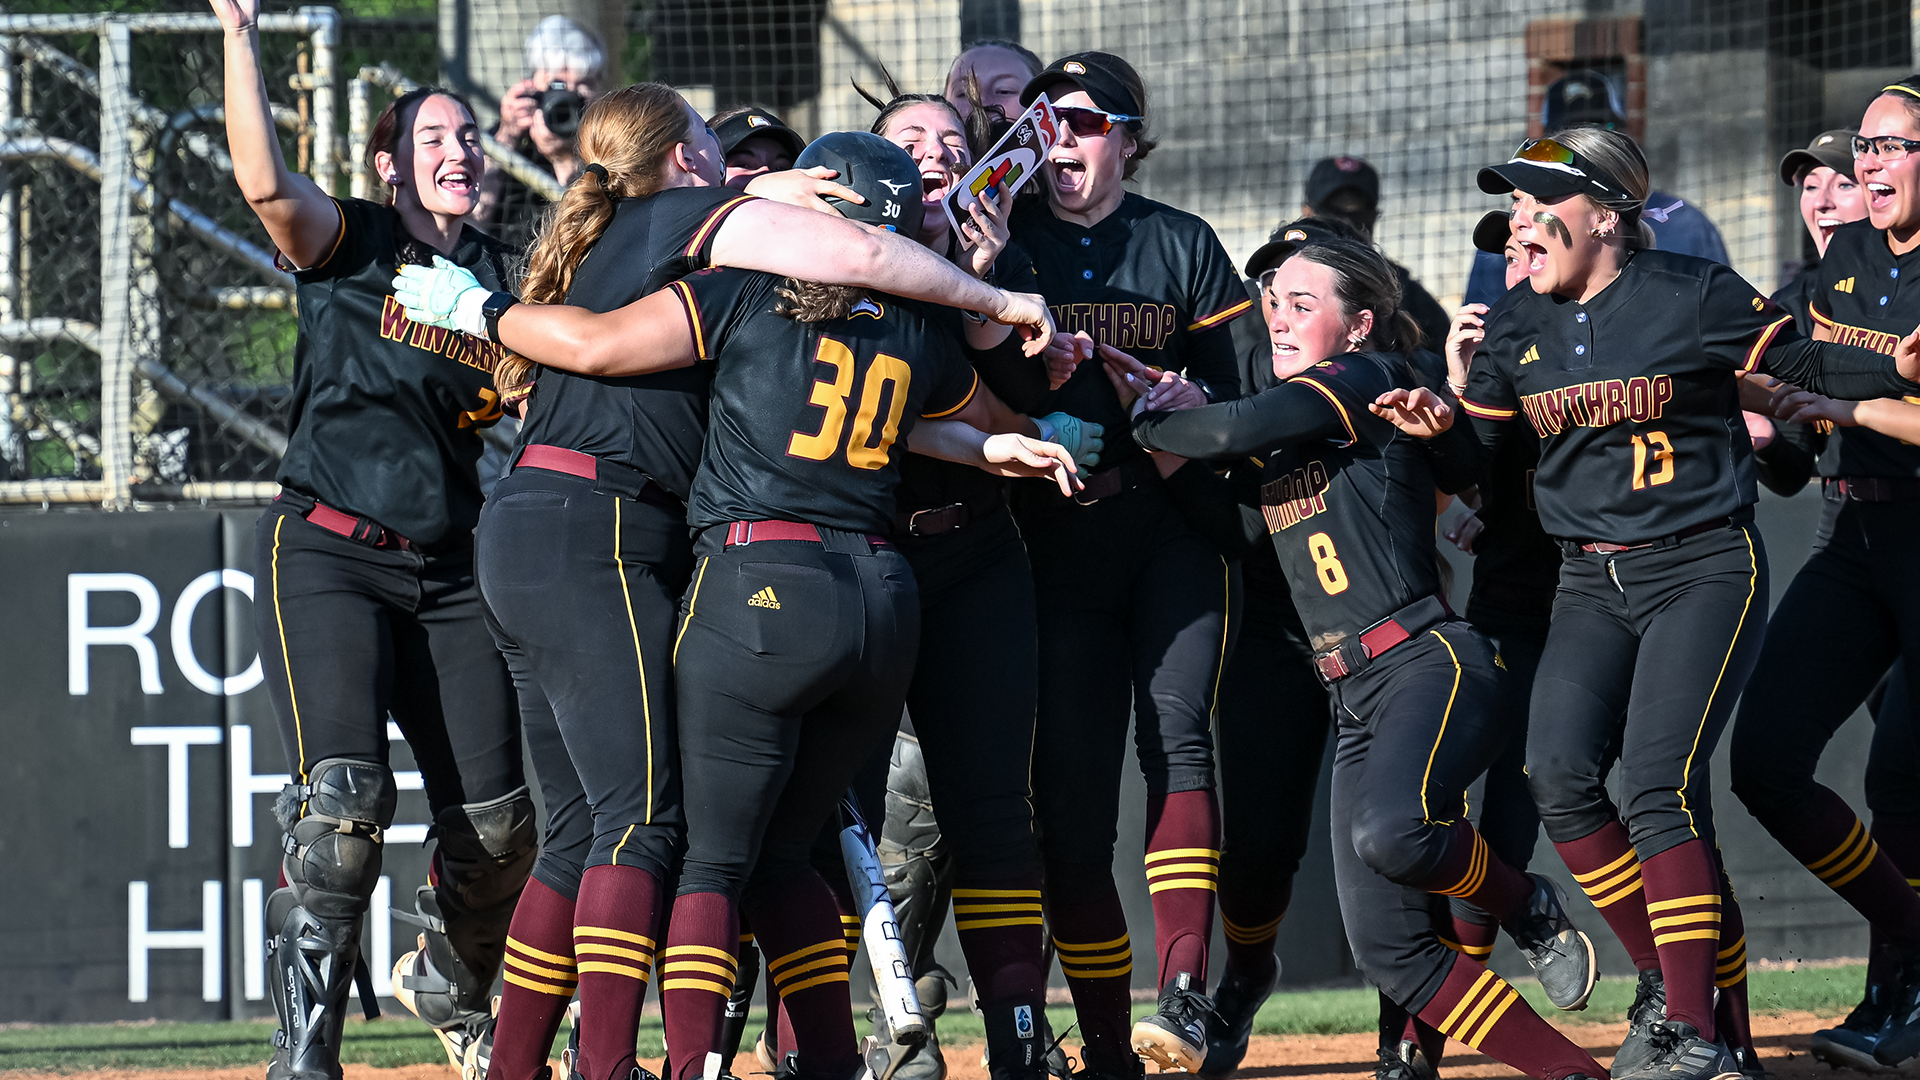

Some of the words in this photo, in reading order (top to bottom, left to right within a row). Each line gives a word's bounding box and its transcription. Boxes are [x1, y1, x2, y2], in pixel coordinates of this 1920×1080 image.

[882, 199, 901, 218] 30
[785, 335, 912, 471] 30
[1630, 430, 1675, 491] 13
[1308, 531, 1350, 596] 8
[747, 598, 781, 610] adidas
